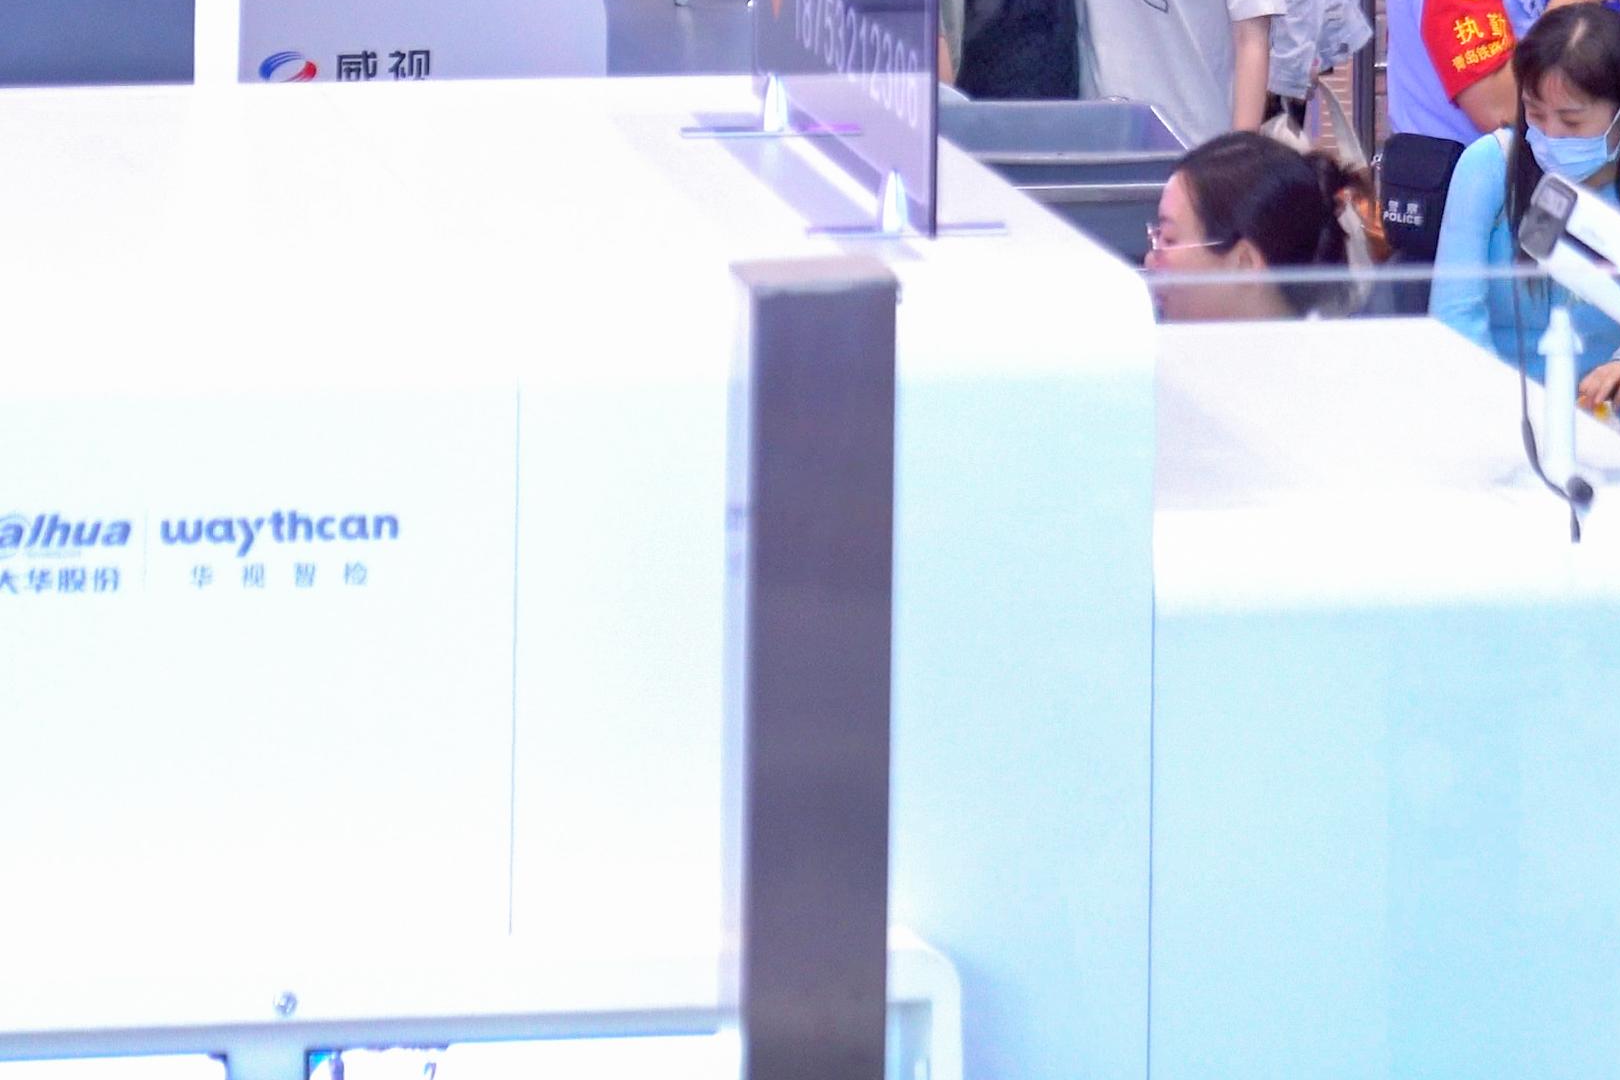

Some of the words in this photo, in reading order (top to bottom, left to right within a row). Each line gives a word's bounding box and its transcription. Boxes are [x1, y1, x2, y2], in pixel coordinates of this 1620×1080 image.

[336, 49, 431, 82] 威视
[1383, 210, 1423, 226] POLICE
[160, 510, 400, 557] waythcan
